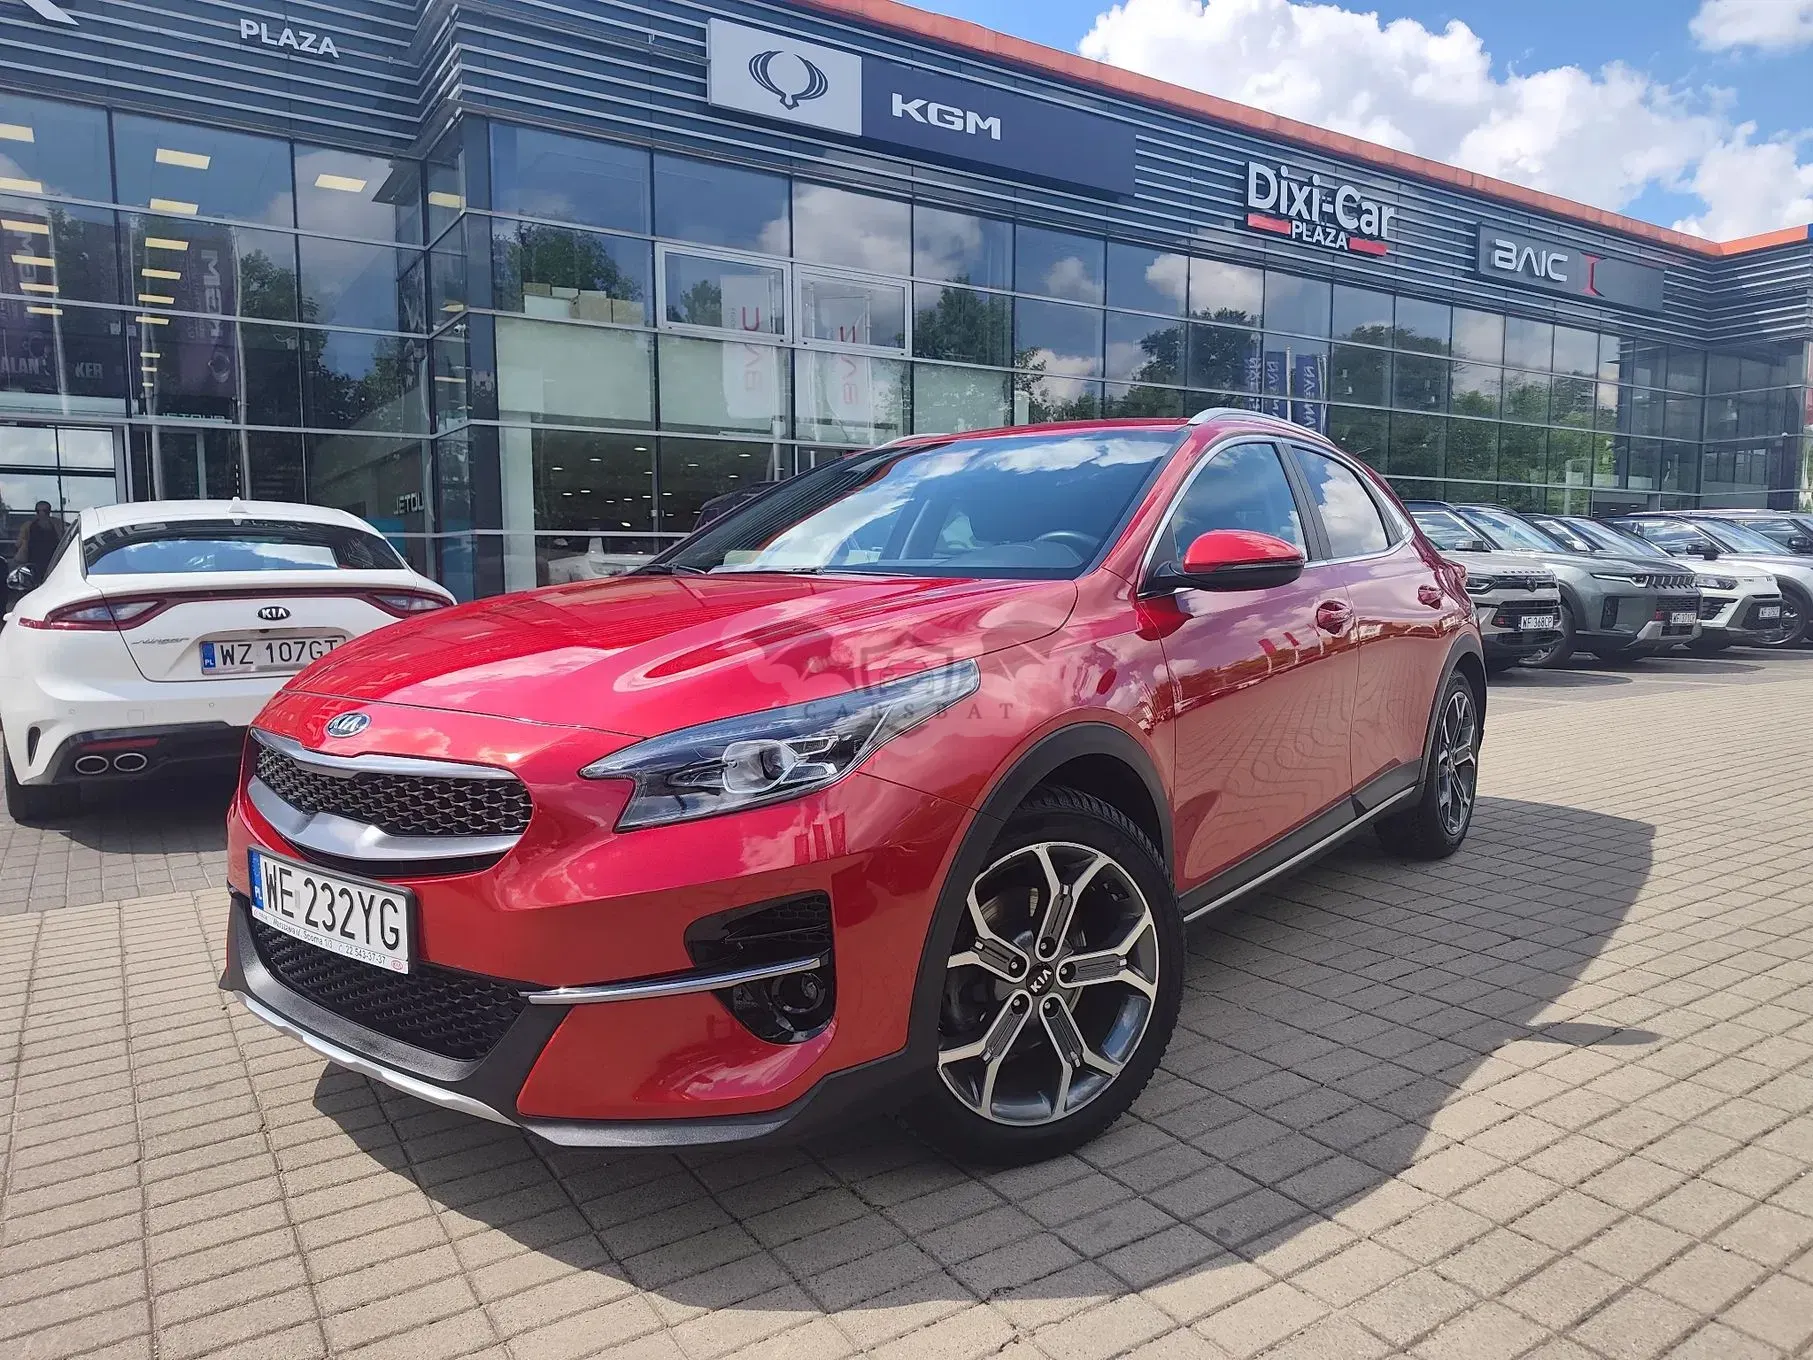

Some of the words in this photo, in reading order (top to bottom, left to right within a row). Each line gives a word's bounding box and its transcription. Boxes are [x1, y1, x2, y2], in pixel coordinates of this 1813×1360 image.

[239, 18, 341, 59] PLAZA
[892, 92, 1002, 141] KGM
[1246, 160, 1399, 239] Dixi-Car
[1290, 222, 1350, 251] PLAZA
[1492, 237, 1569, 283] BAIC
[261, 607, 287, 618] KIA
[204, 658, 215, 666] PL
[220, 643, 254, 666] WZ
[265, 639, 339, 664] 107GT
[254, 886, 264, 900] PL
[263, 861, 295, 919] WE
[303, 876, 400, 951] 232YG
[1029, 969, 1052, 993] KIA
